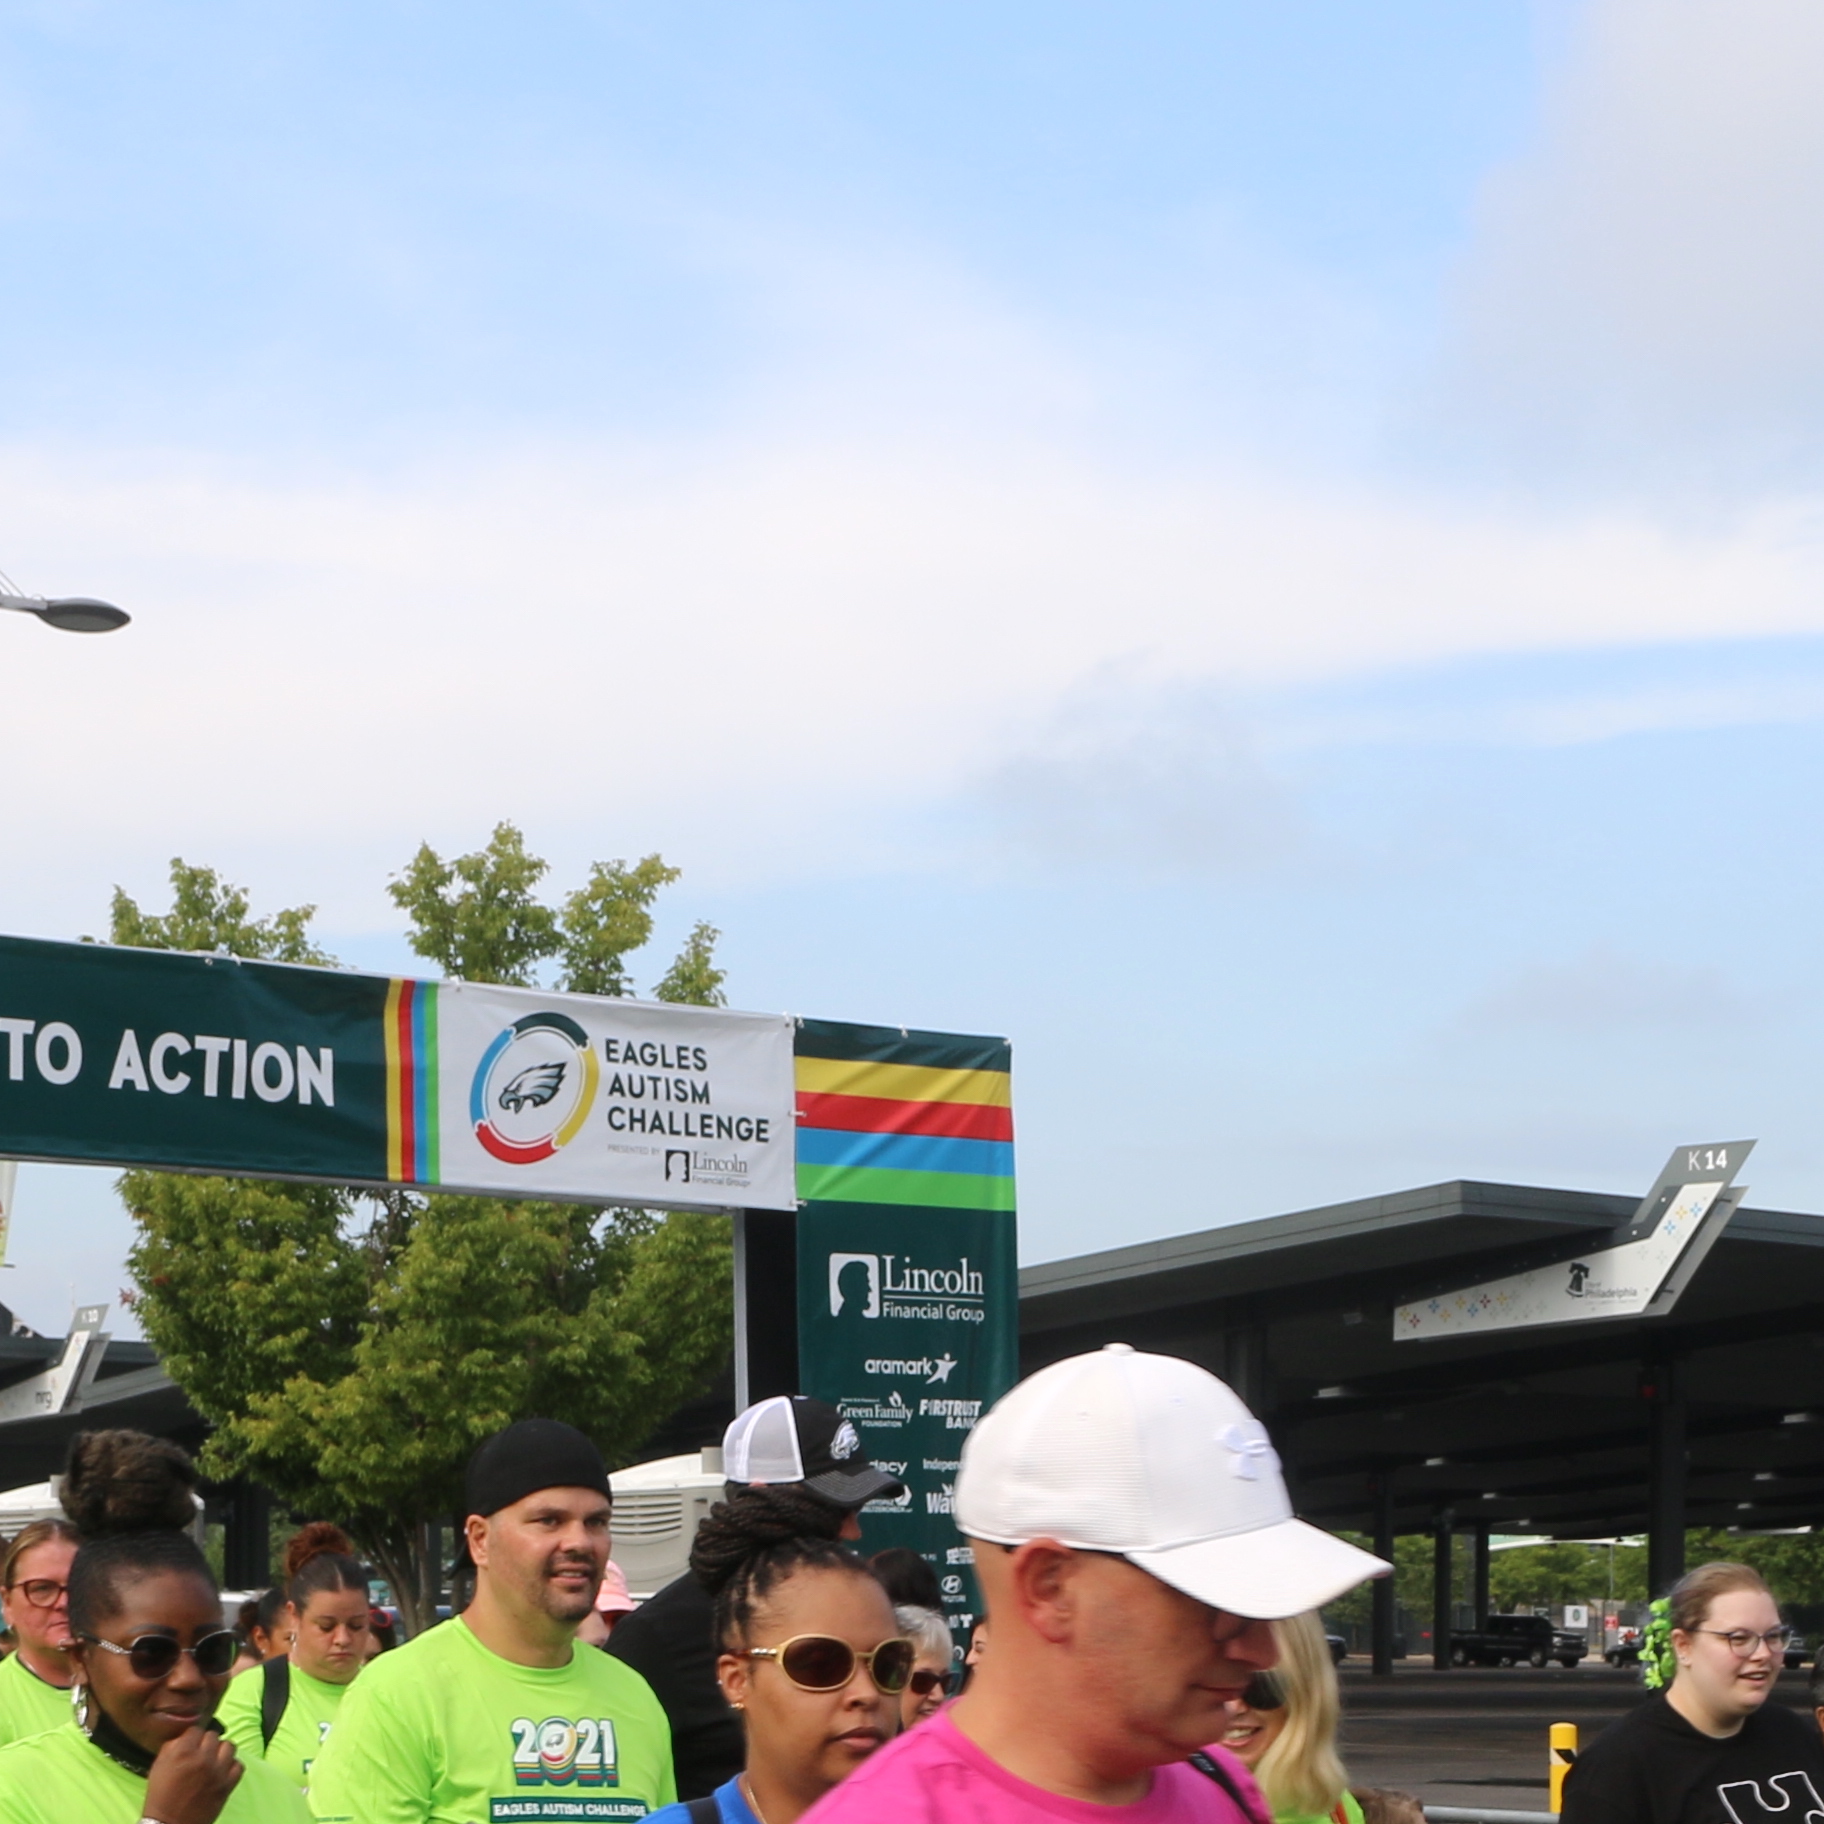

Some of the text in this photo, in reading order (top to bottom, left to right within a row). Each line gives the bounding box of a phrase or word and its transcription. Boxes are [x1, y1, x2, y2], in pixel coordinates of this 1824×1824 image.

[605, 1038, 708, 1071] EAGLES
[108, 1029, 336, 1107] ACTION
[608, 1072, 711, 1105] AUTISM
[607, 1106, 770, 1143] CHALLENGE
[692, 1151, 748, 1174] Lincoln
[1688, 1149, 1727, 1171] K 14
[692, 1175, 724, 1186] Financial
[882, 1255, 984, 1295] Lincoln
[882, 1302, 985, 1325] Financial Group
[865, 1356, 933, 1375] aramark
[836, 1403, 914, 1423] Green Family
[919, 1399, 982, 1416] FIRSTRUST
[511, 1718, 617, 1778] 2021
[493, 1802, 647, 1818] EAGLES AUTISM CHALLENGE
